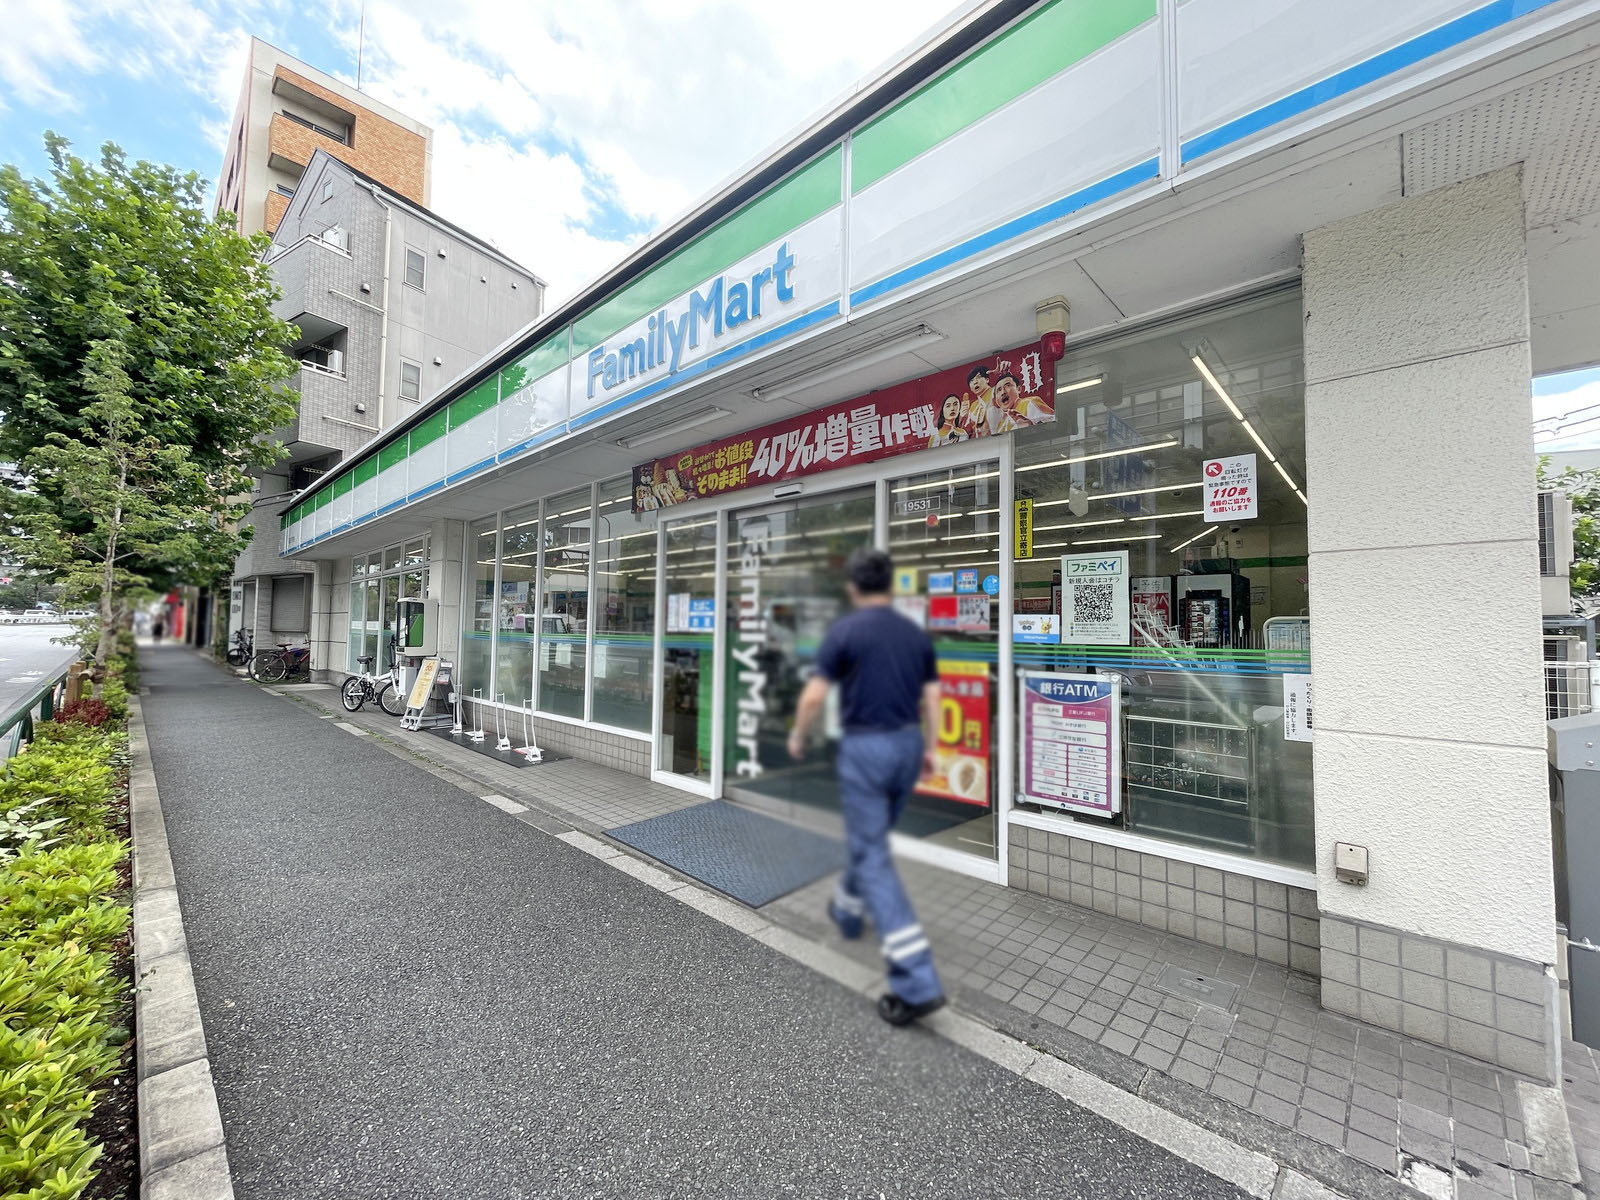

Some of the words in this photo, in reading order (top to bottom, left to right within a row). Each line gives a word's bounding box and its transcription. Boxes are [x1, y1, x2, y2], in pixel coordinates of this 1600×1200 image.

[587, 240, 795, 399] FamilyMart
[747, 403, 938, 478] 40%増量作戦
[714, 440, 755, 469] お値段
[1213, 486, 1249, 499] 110番
[903, 500, 931, 512] 19531
[1213, 504, 1249, 513] お願いします
[1071, 560, 1117, 573] ファミペイ
[1068, 576, 1120, 585] 新規入会はコチラ
[732, 525, 768, 778] FamilyMart
[1040, 682, 1098, 698] 銀行ATM
